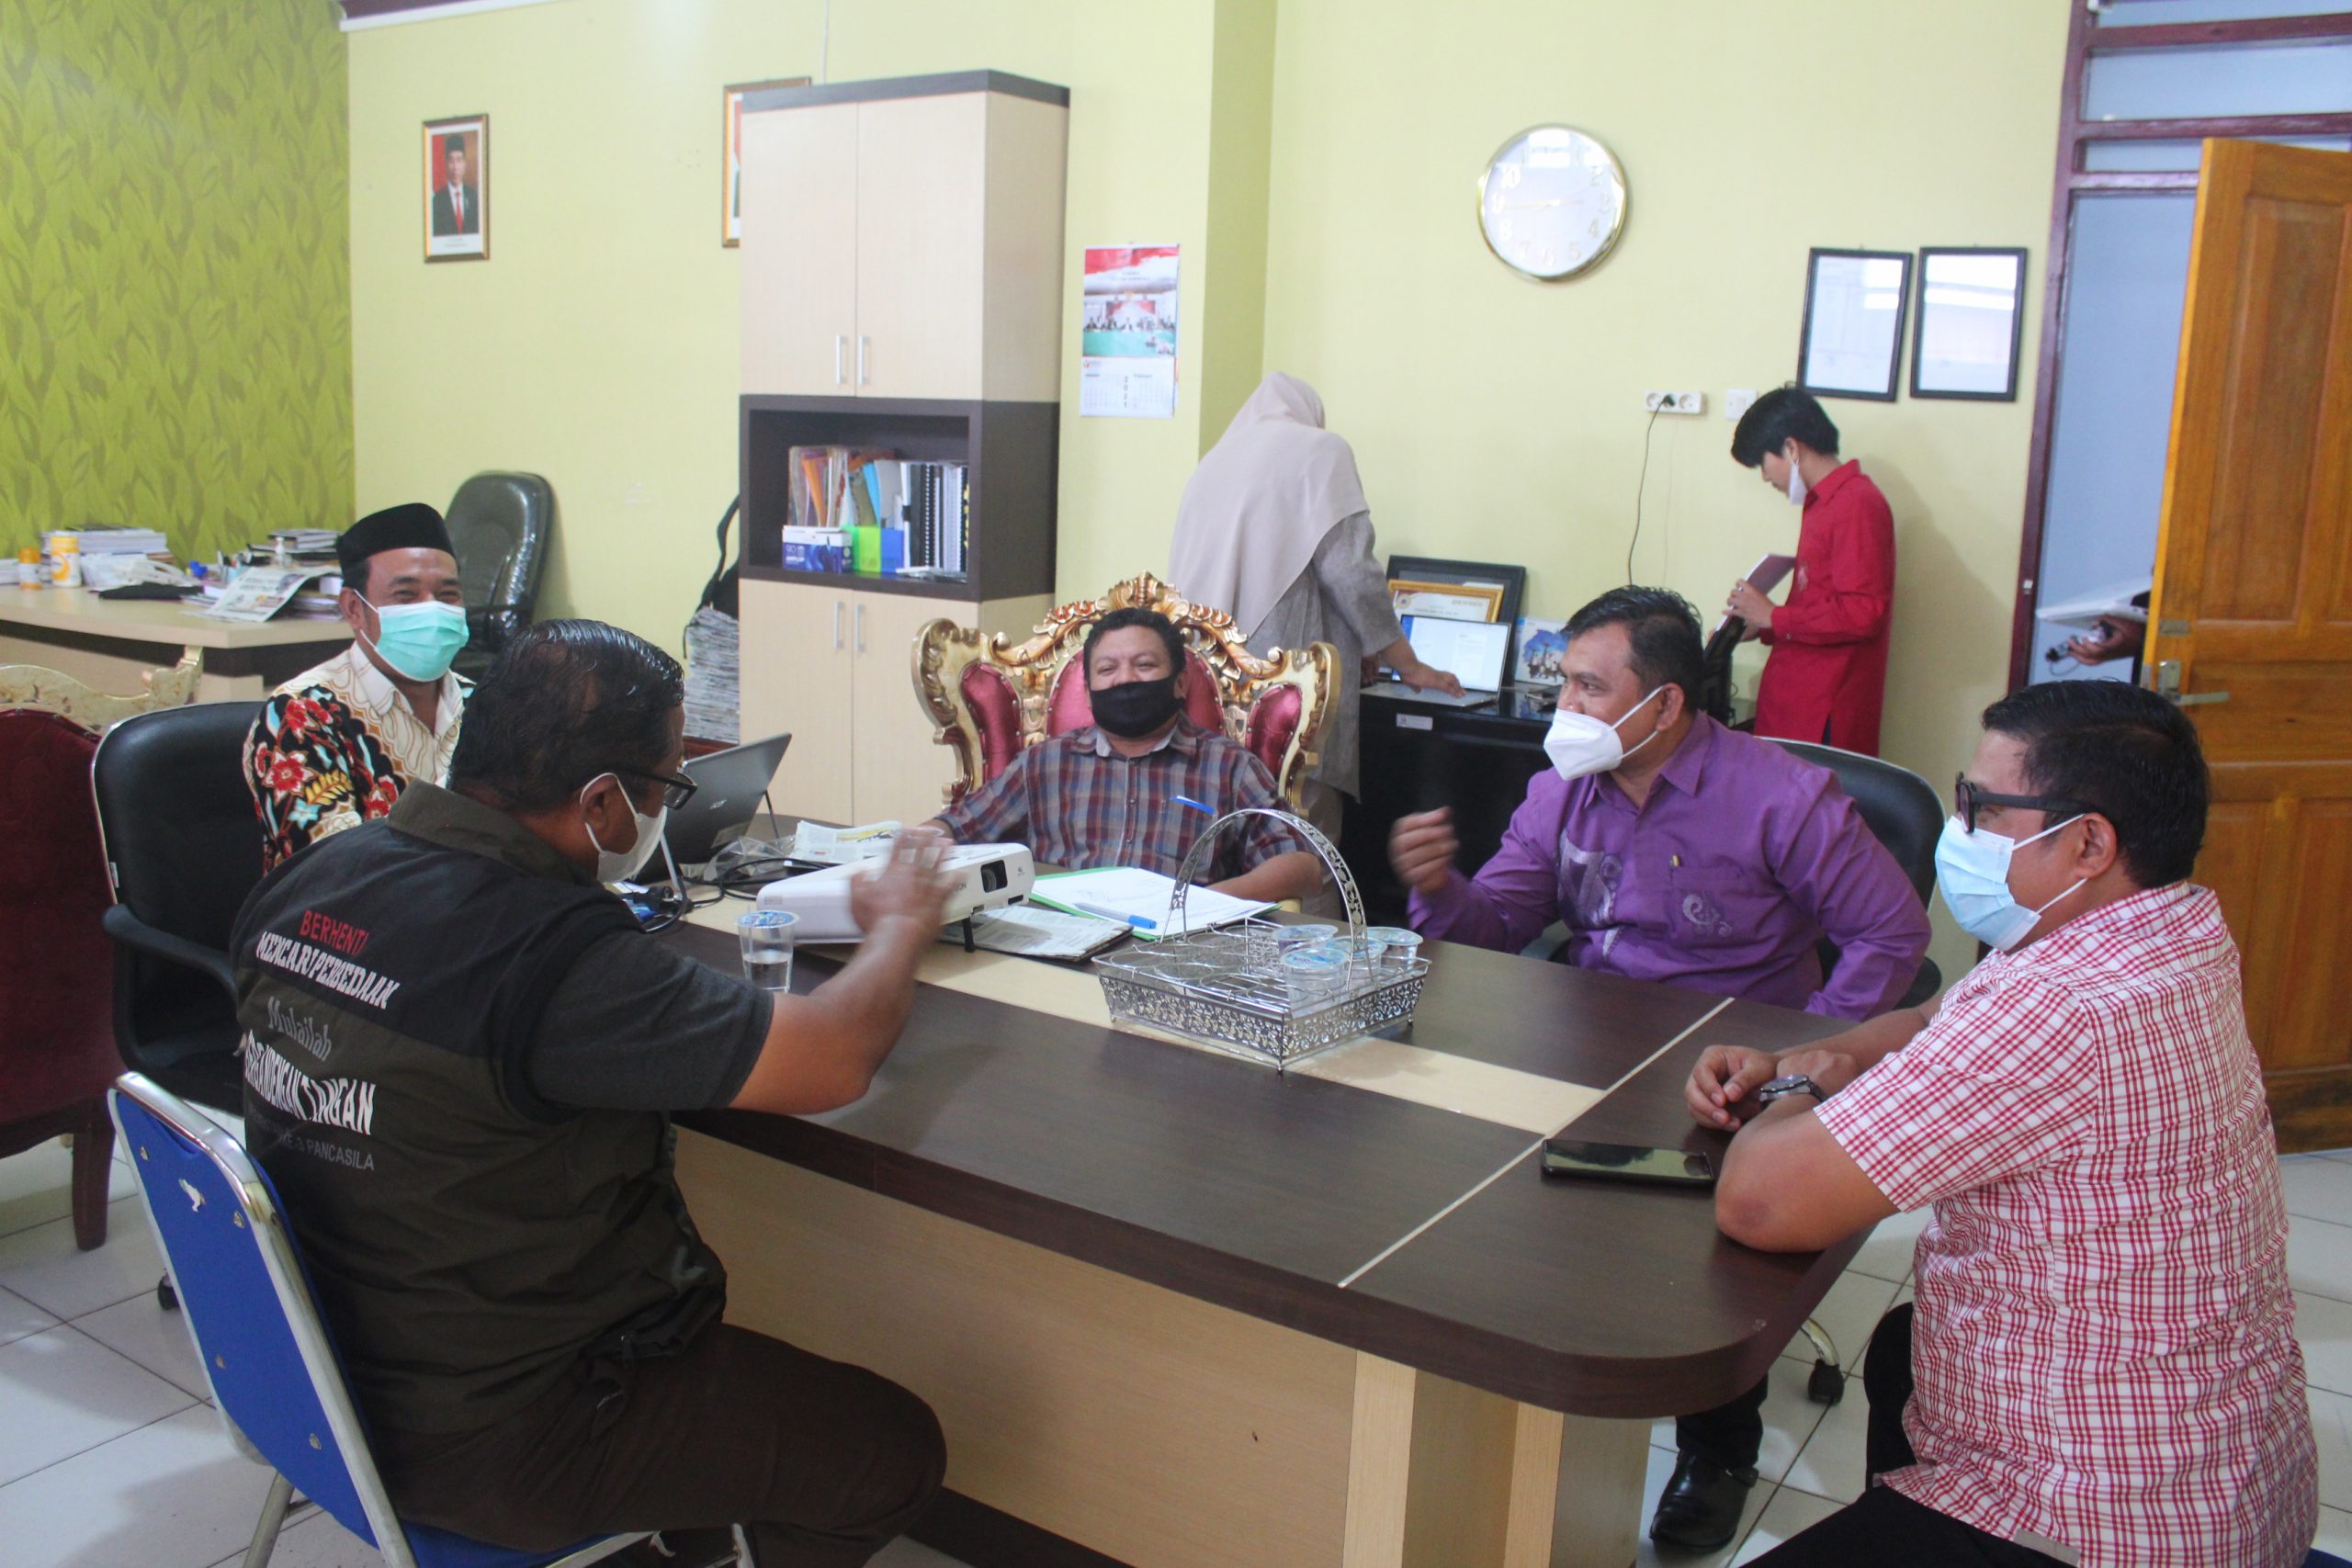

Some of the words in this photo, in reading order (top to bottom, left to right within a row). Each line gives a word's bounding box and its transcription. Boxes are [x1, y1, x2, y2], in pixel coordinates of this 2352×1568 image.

[255, 931, 320, 976] MENCARI
[299, 909, 369, 955] BERHENTI
[267, 996, 332, 1062] Mulailah
[306, 1138, 375, 1171] PANCASILA
